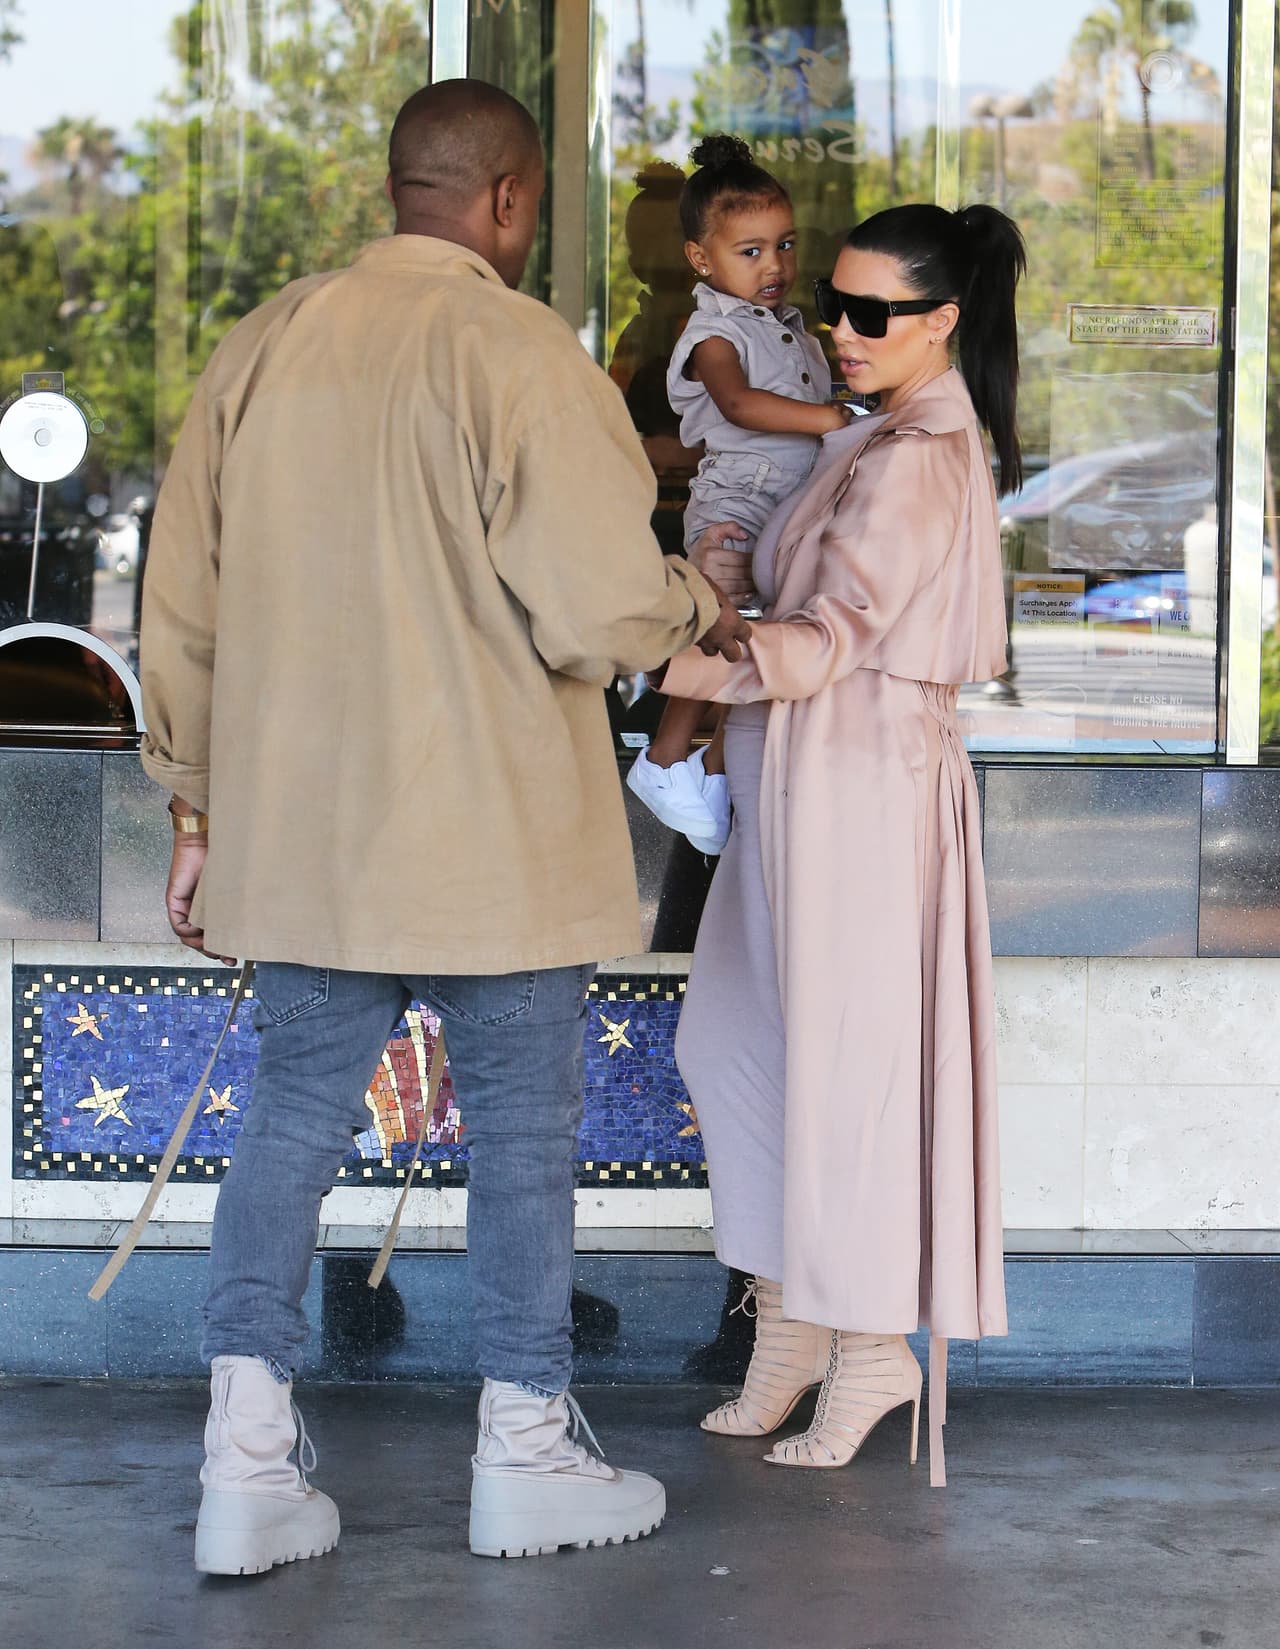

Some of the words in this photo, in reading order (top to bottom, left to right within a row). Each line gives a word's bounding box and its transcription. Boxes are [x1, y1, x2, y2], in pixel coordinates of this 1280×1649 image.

[1088, 315, 1102, 324] NO
[1104, 316, 1148, 325] REFUNDS
[1151, 317, 1178, 326] AFTER
[1181, 318, 1199, 326] THE
[1076, 325, 1103, 333] START
[1106, 326, 1119, 334] OF
[1122, 326, 1140, 335] THE
[1142, 327, 1209, 336] PRESENTATION
[1019, 599, 1057, 608] Surcharges
[1047, 609, 1077, 617] Location
[1169, 610, 1182, 621] WE
[1133, 695, 1167, 705] PLEASE
[1169, 695, 1183, 705] NO
